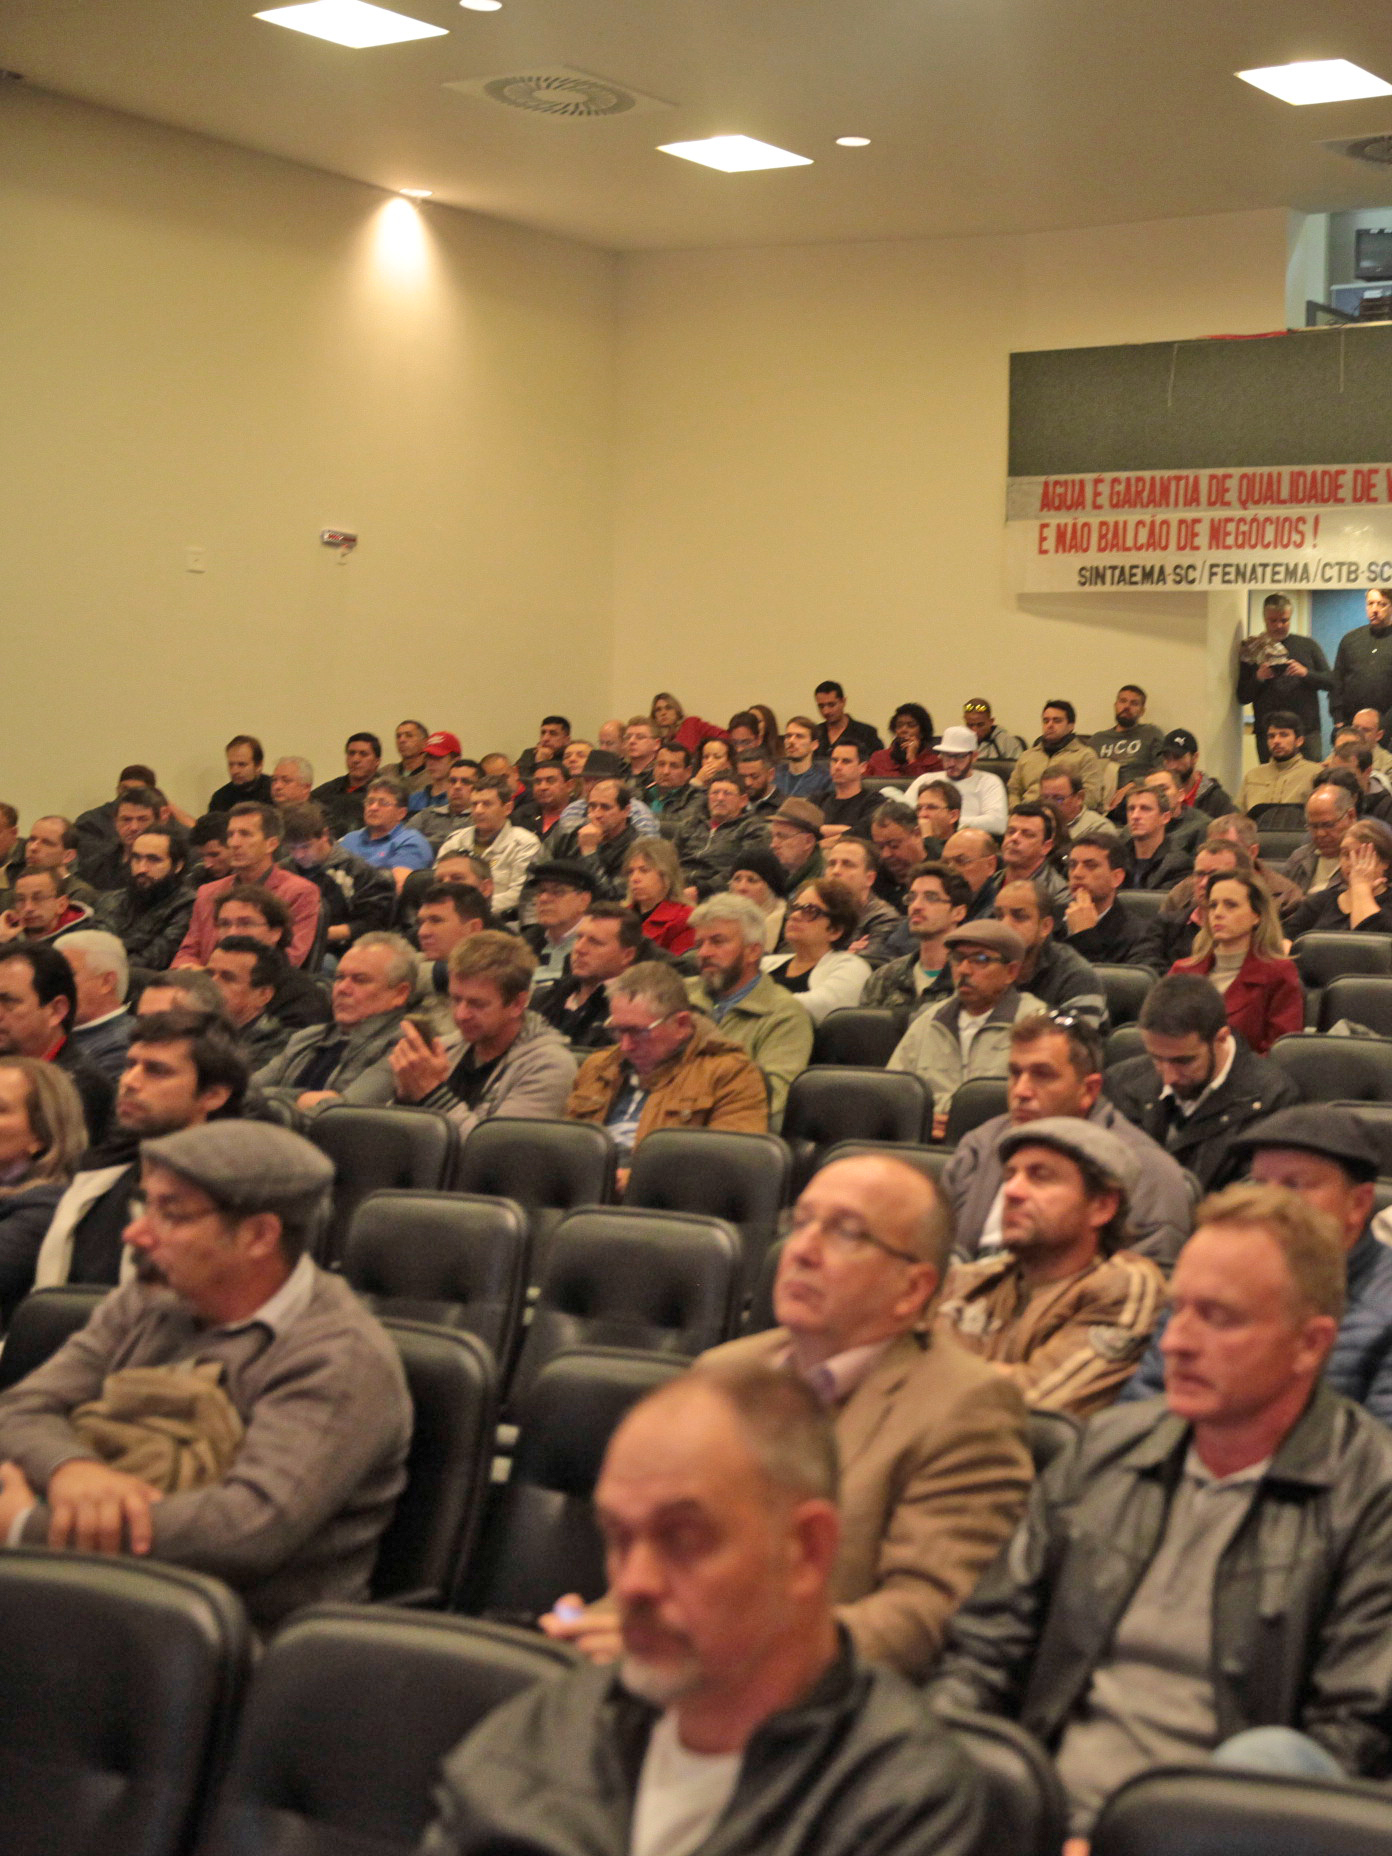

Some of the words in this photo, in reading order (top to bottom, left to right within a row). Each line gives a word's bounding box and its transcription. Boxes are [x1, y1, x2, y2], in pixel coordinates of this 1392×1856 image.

[1040, 476, 1086, 512] ÁGUA
[1092, 474, 1105, 510] É
[1109, 475, 1200, 509] GARANTIA
[1207, 473, 1233, 507] DE
[1238, 469, 1347, 510] QUALIDADE
[1352, 468, 1380, 503] DE
[1038, 523, 1051, 555] E
[1054, 516, 1092, 554] NÃO
[1097, 514, 1171, 553] BALCÃO
[1176, 518, 1203, 551] DE
